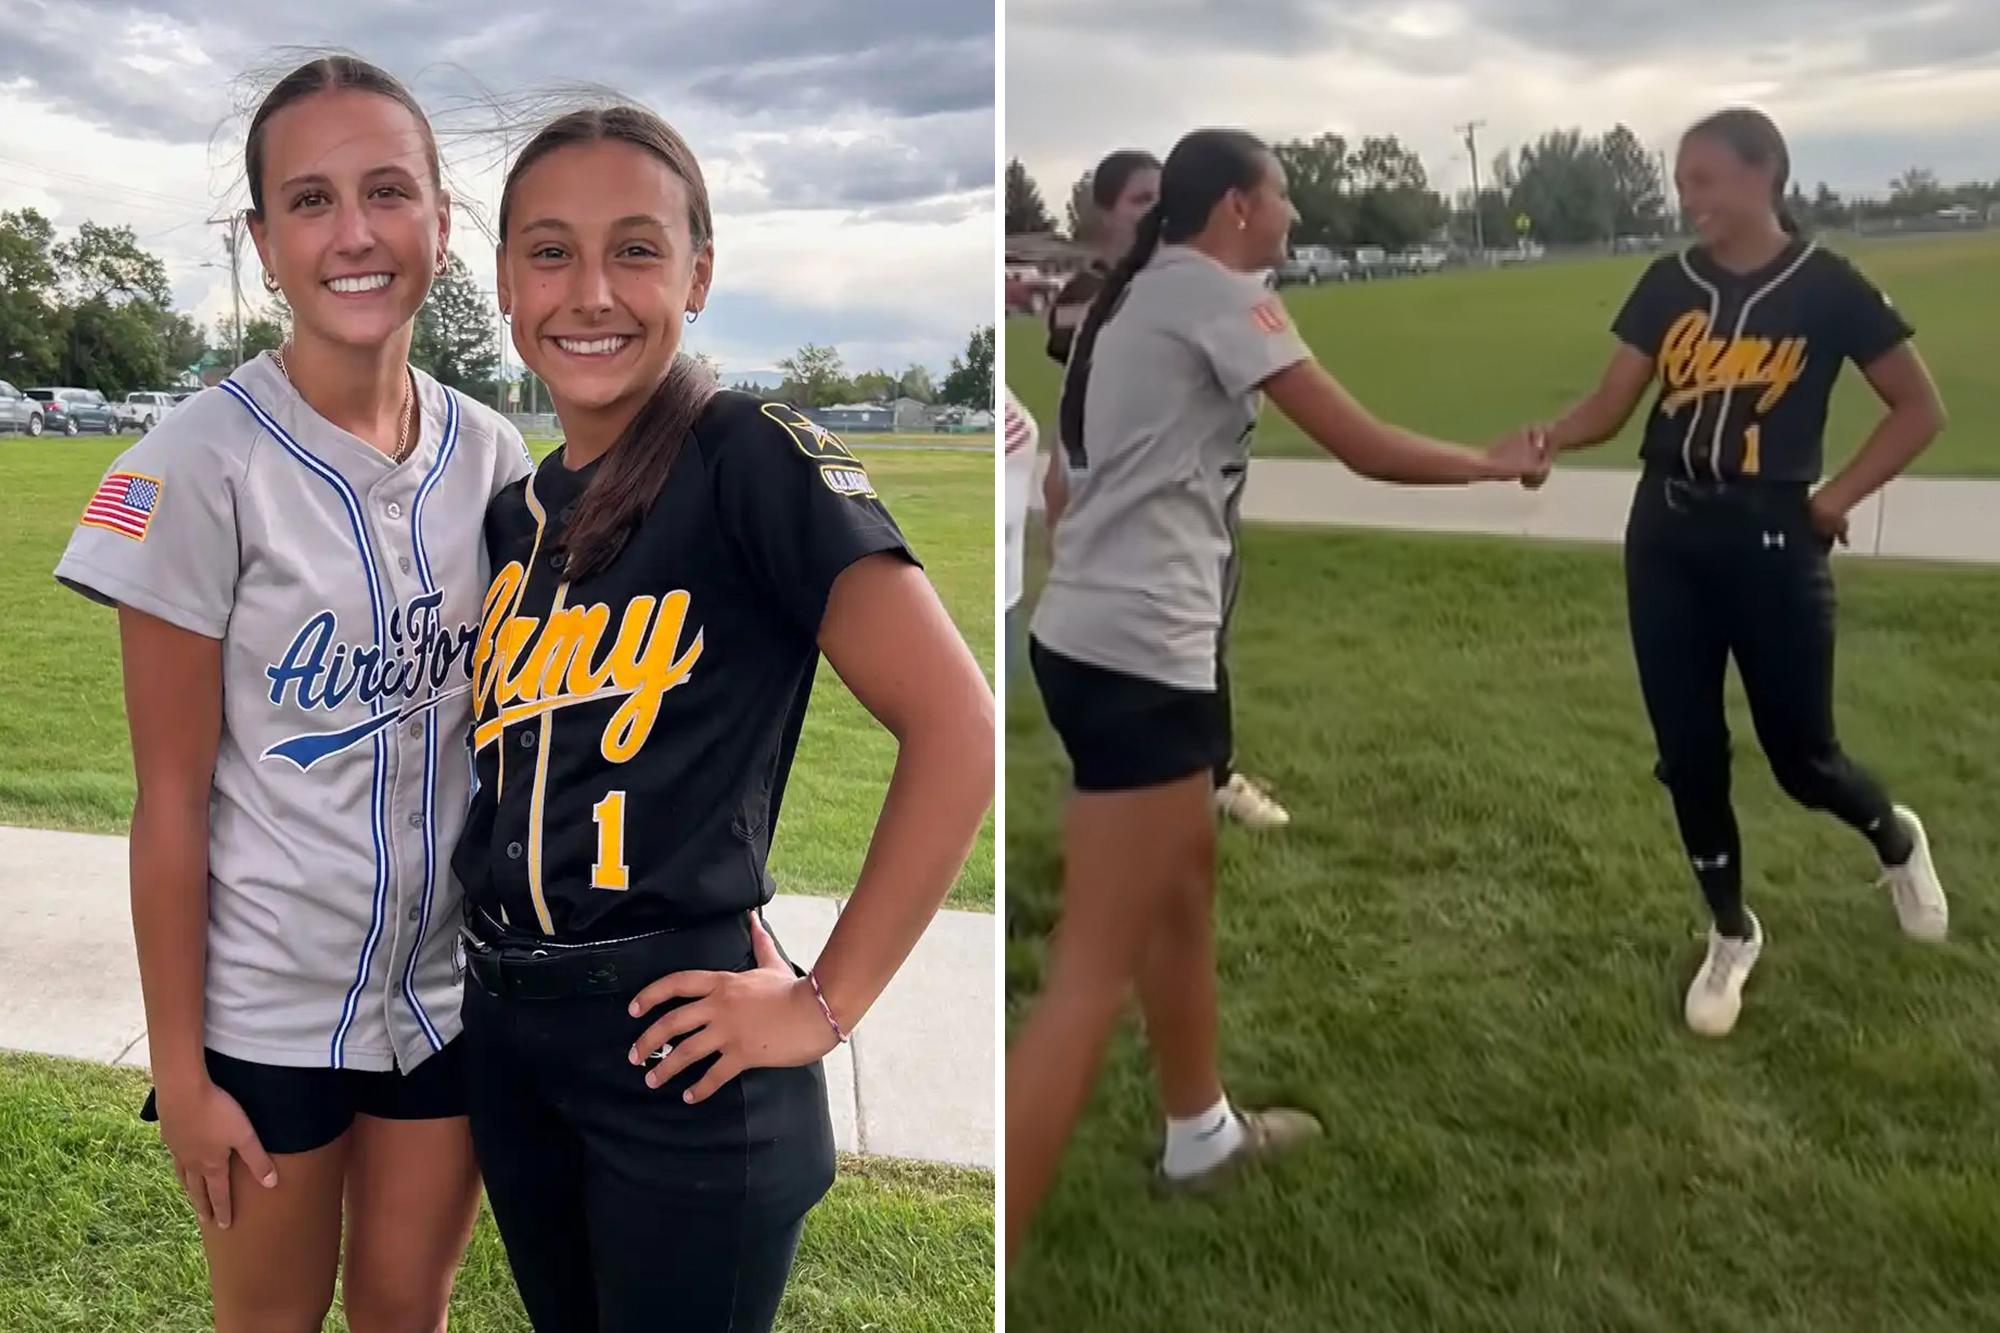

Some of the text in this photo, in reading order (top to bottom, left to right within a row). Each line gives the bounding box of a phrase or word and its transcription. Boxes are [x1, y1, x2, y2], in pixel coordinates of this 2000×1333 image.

[1658, 309, 1808, 413] Army
[1743, 424, 1760, 473] 1
[265, 588, 479, 711] Air For
[472, 561, 704, 764] Army
[591, 790, 630, 891] 1
